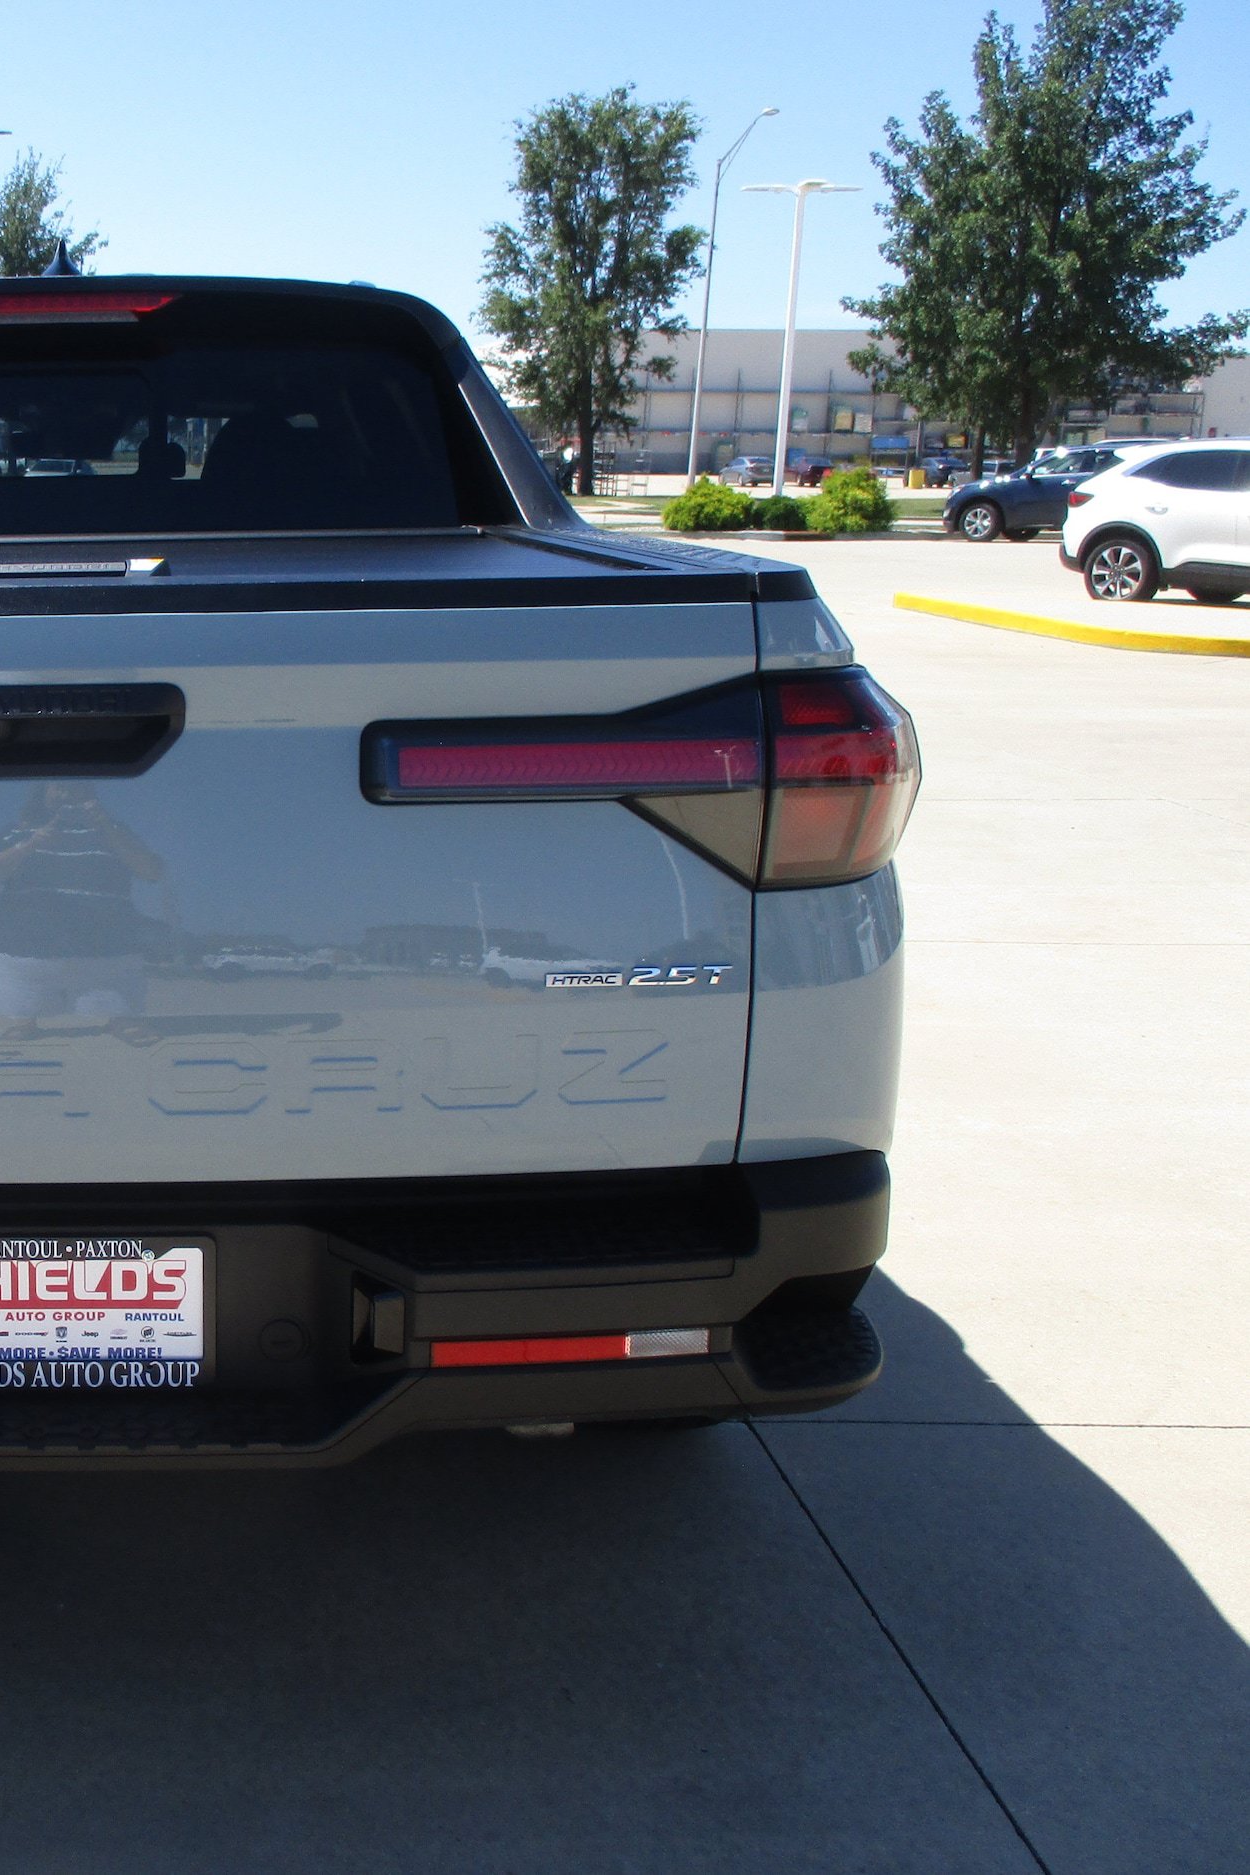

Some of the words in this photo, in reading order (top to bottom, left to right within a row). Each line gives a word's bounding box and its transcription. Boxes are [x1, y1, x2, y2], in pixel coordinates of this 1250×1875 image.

[551, 974, 618, 986] HTRAC
[146, 1030, 670, 1115] CRUZ
[75, 1239, 142, 1258] PAXTON
[5, 1312, 46, 1322] AUTO
[52, 1311, 106, 1321] GROUP
[125, 1313, 185, 1322] RANTOUL
[81, 1330, 99, 1338] Jeep
[107, 1347, 163, 1360] MORE!
[31, 1361, 104, 1388] AUTO
[109, 1361, 199, 1388] GROUP
